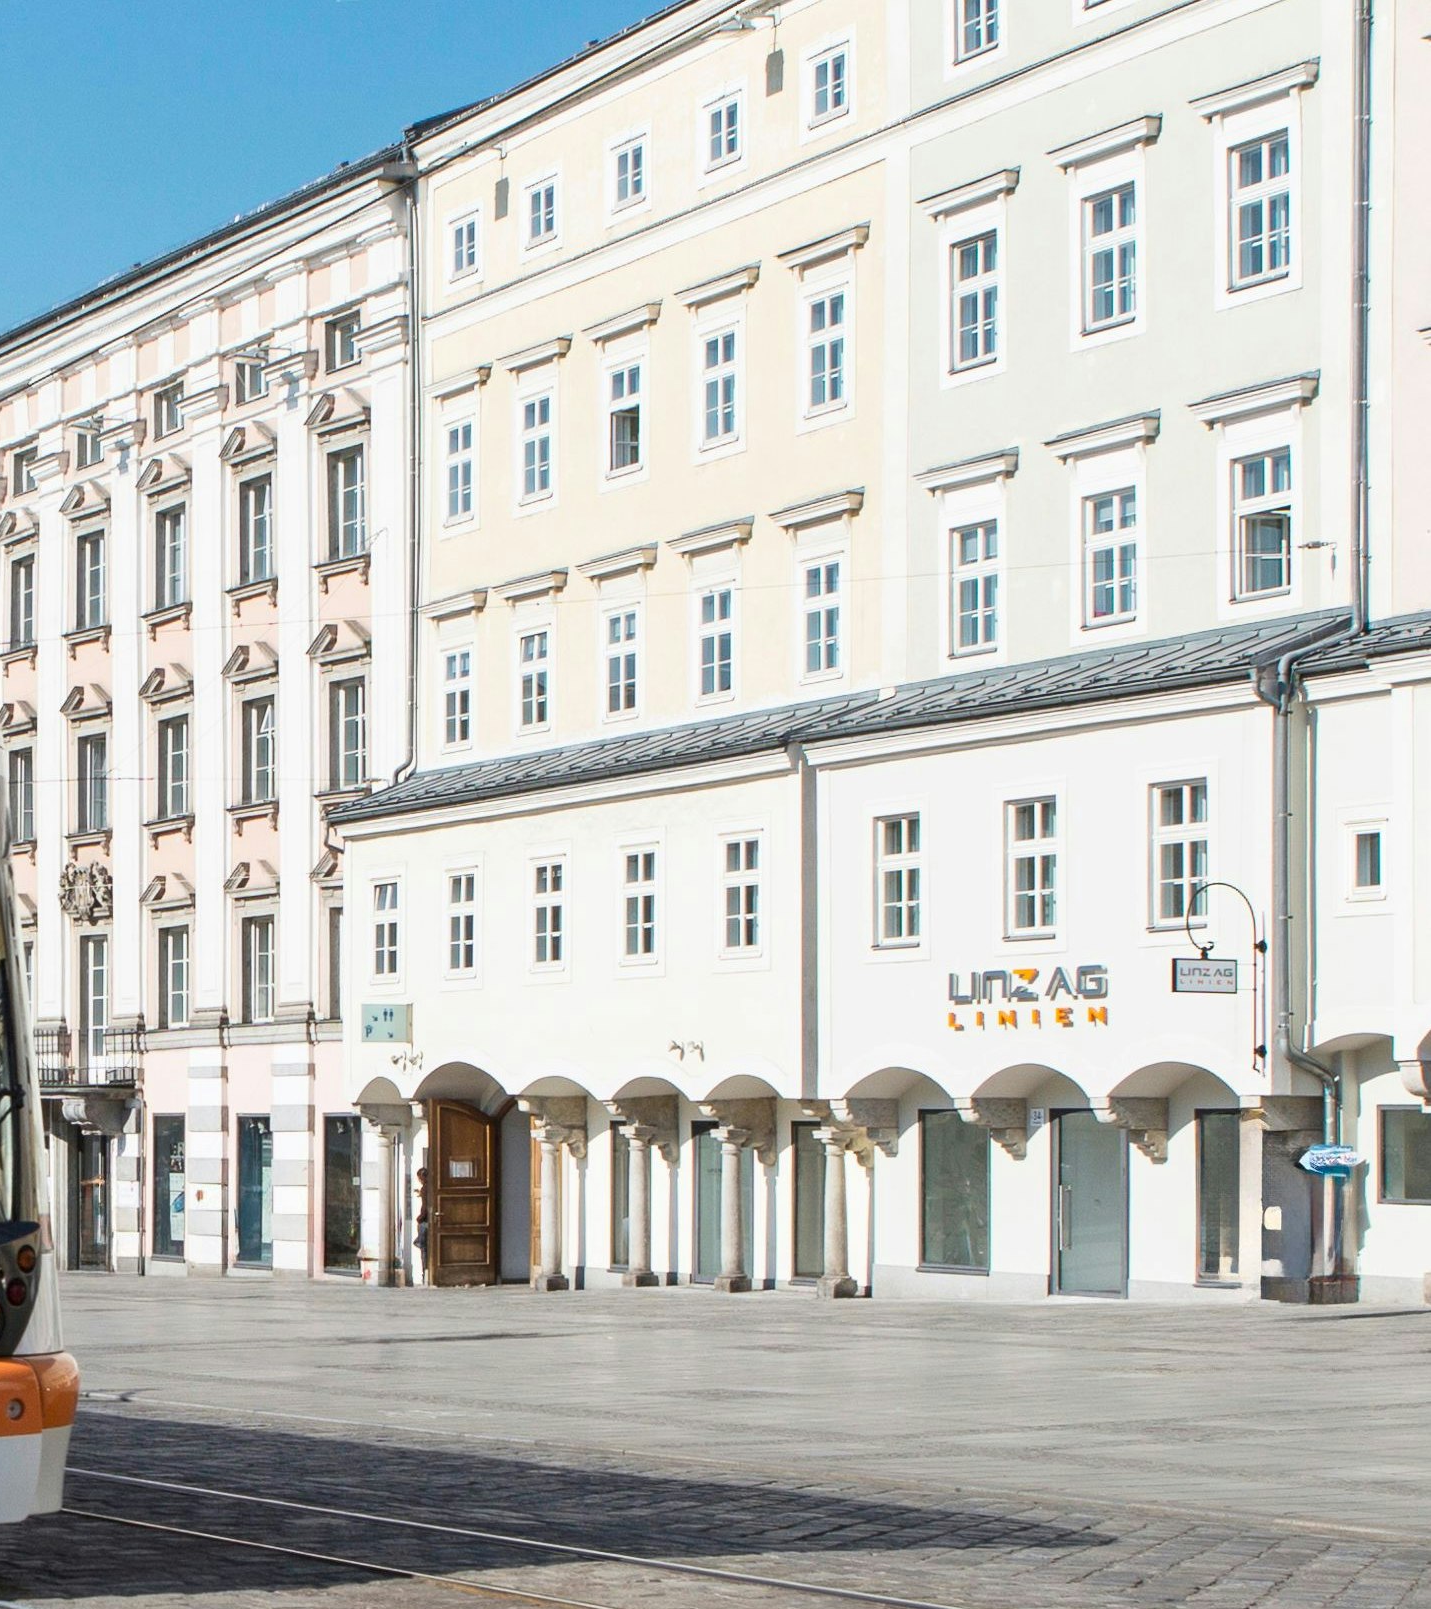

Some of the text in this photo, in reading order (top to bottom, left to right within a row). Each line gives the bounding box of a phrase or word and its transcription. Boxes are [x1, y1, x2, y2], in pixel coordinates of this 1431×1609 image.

[948, 965, 1108, 1005] LINZ AG
[1180, 968, 1233, 977] LINZ AG
[948, 1006, 1108, 1031] LINIEN
